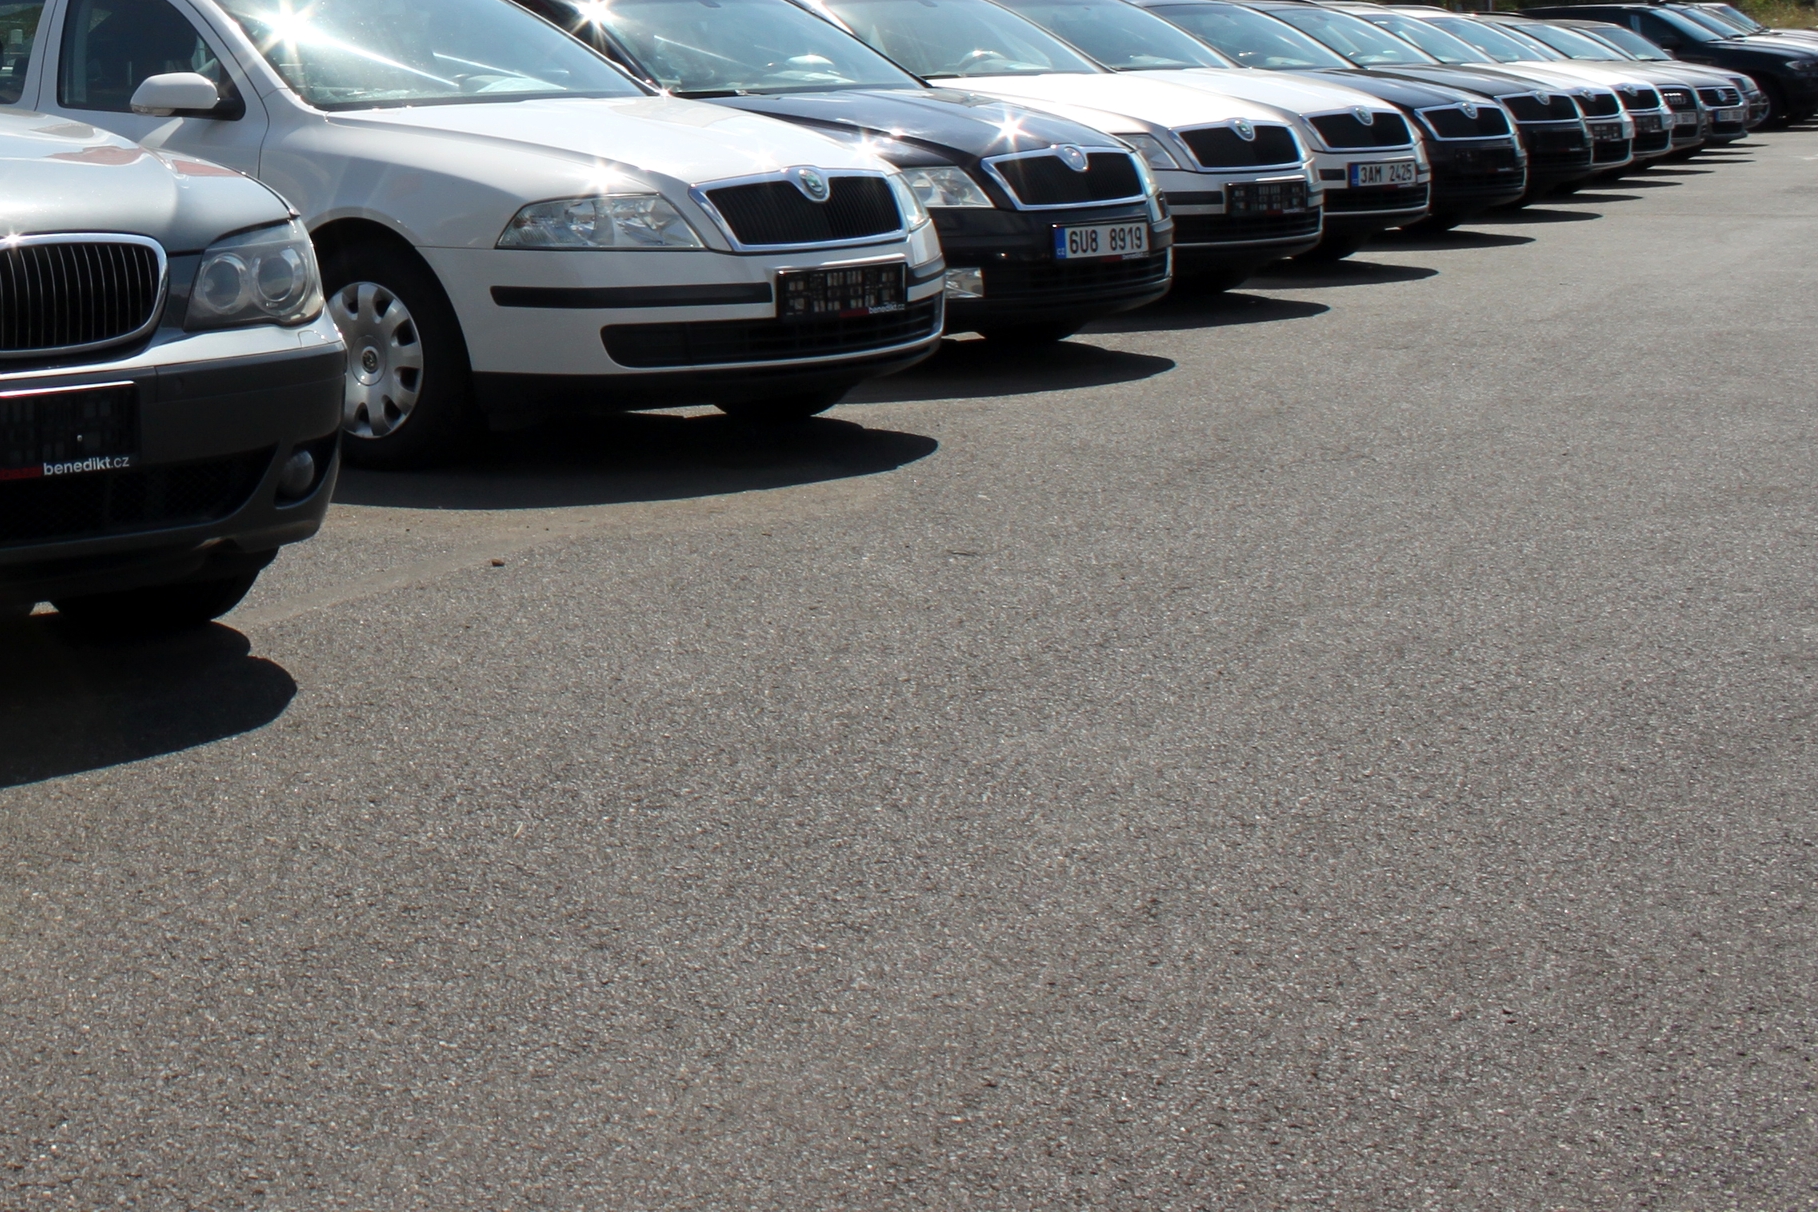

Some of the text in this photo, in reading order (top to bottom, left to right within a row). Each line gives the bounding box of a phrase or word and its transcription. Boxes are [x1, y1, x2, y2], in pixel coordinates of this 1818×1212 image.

[1360, 163, 1412, 183] 3AM 2425
[1069, 226, 1142, 254] 6U8 8919
[43, 455, 130, 476] benedikt.cz
